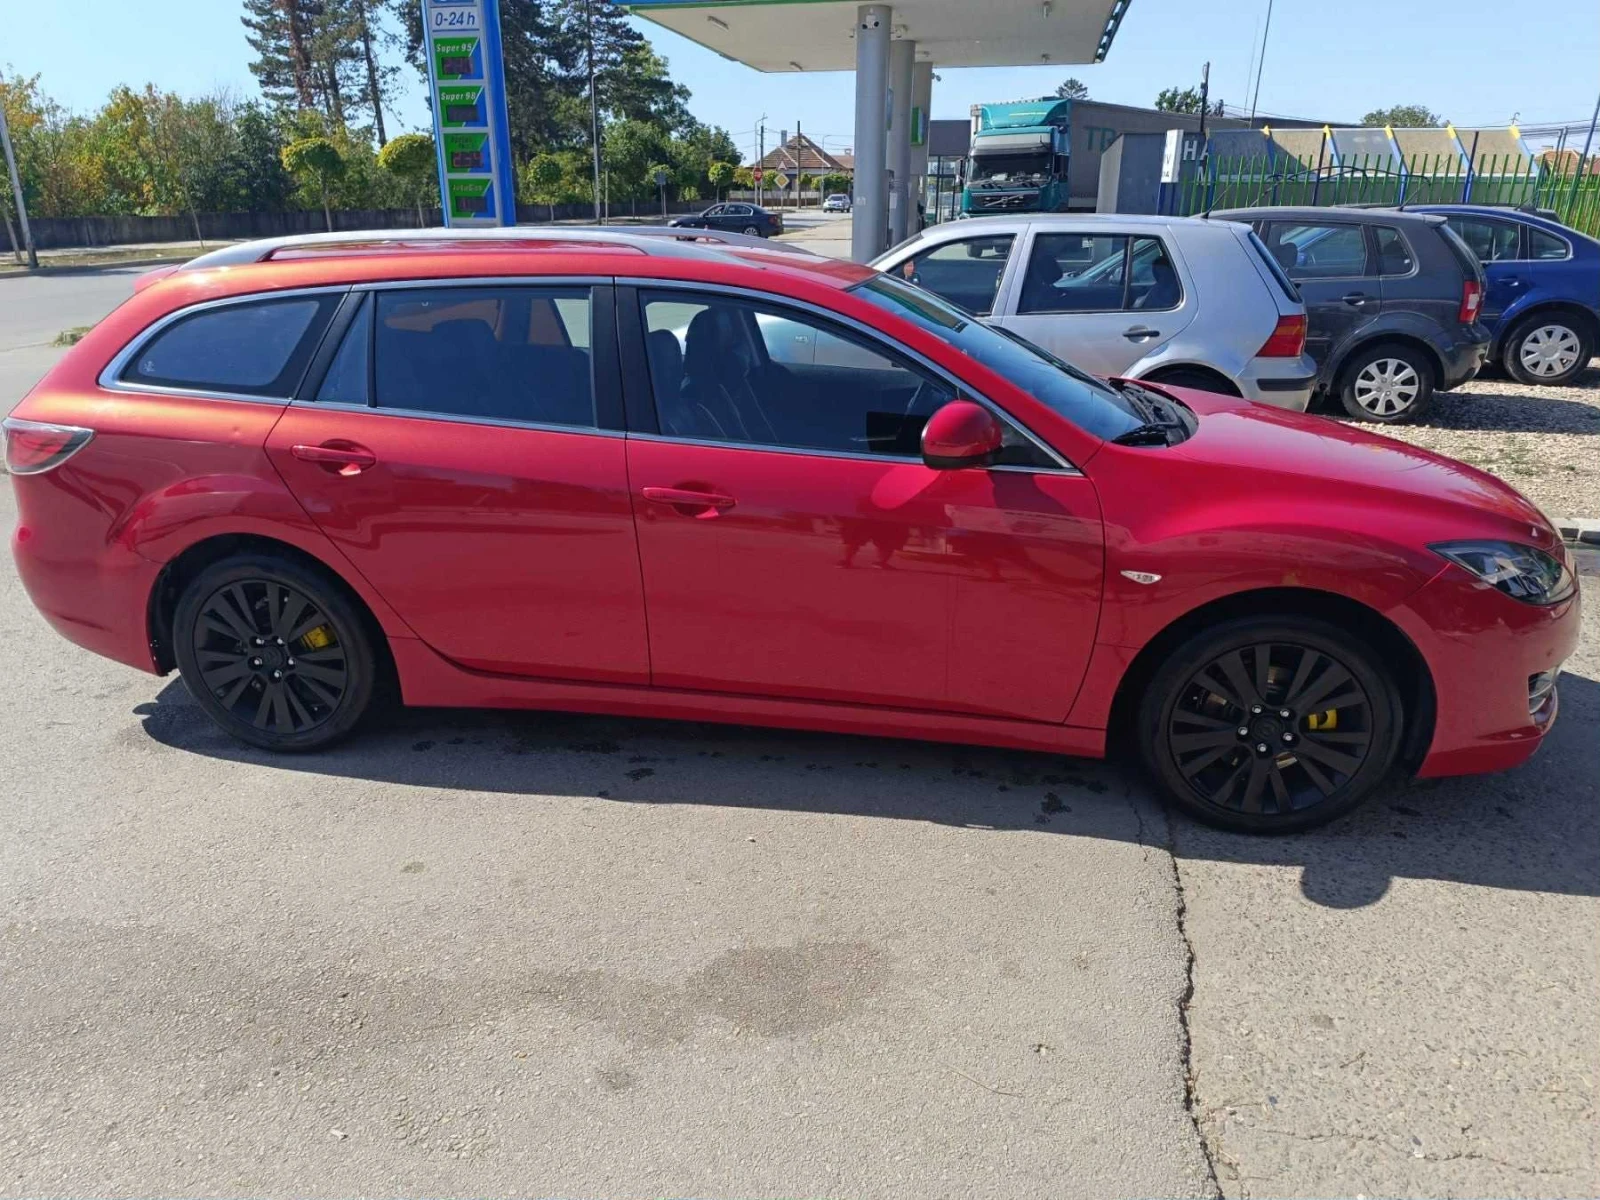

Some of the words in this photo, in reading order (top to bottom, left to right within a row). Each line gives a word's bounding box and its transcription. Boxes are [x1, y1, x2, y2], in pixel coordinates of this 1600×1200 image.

[435, 11, 464, 26] 0-24
[467, 11, 476, 25] h
[436, 43, 460, 53] Super
[461, 43, 472, 52] 95
[440, 92, 464, 102] Super
[465, 91, 476, 100] 98
